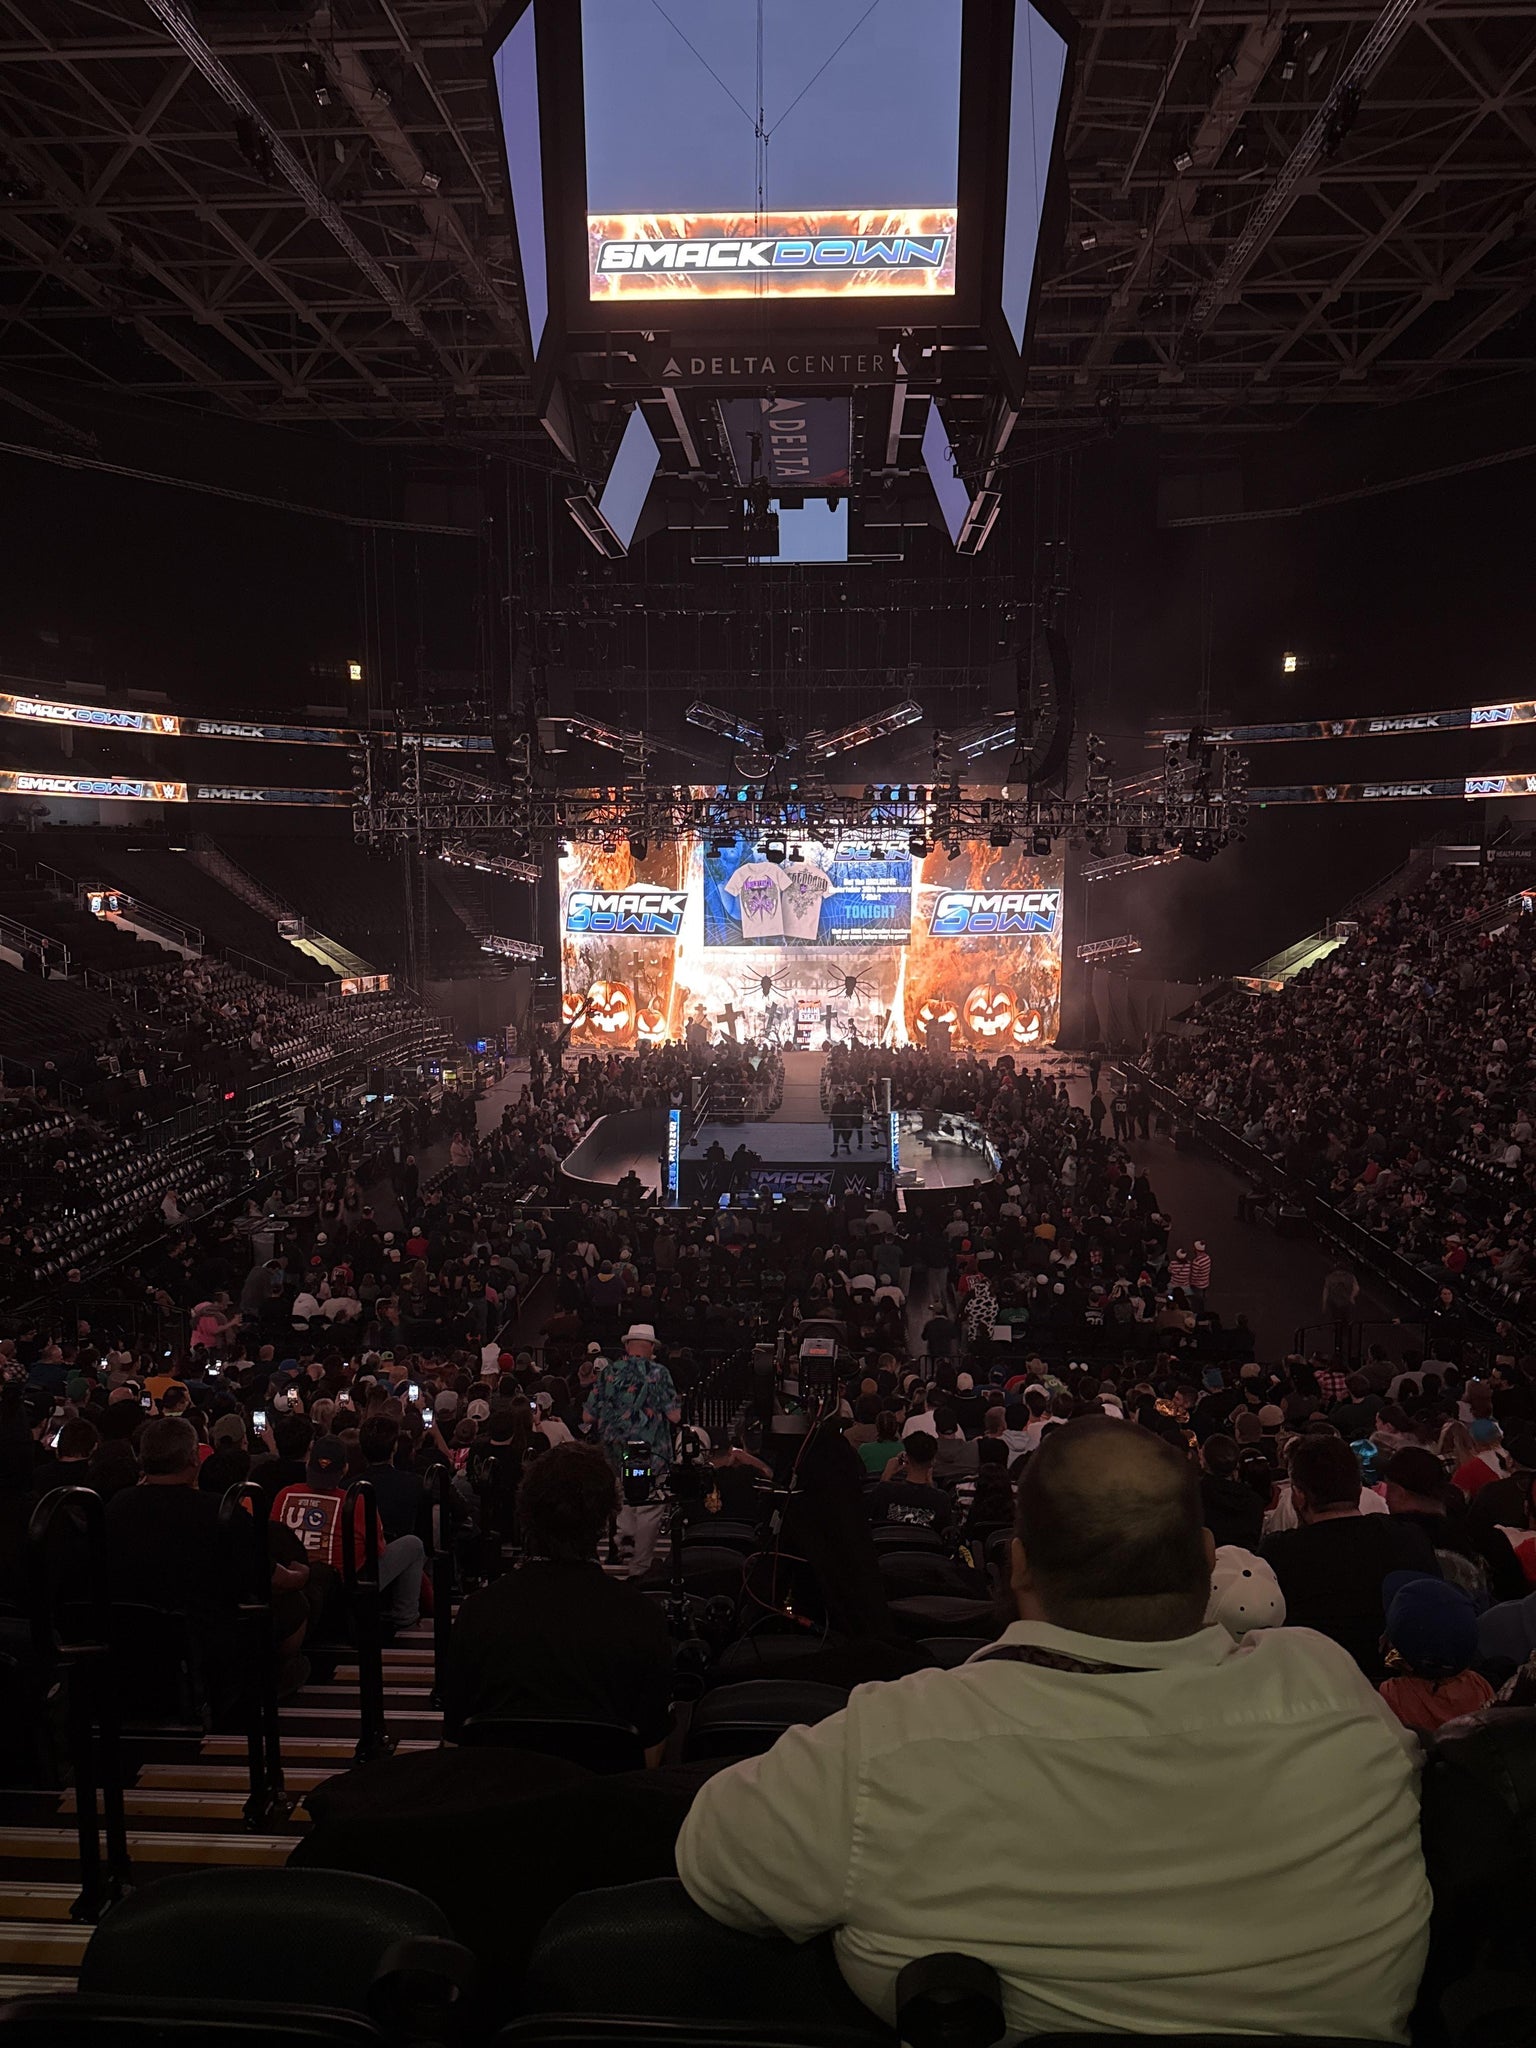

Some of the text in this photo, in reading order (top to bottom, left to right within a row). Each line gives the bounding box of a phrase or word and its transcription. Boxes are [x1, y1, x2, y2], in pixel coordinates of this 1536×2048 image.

[600, 237, 944, 269] SMACKDOWN
[691, 355, 884, 375] DELTA CENTER
[768, 416, 808, 478] DELTA
[16, 700, 142, 728] SMACKDOWN
[17, 776, 142, 797] SMACKDOWN
[845, 904, 896, 919] TONIGHT
